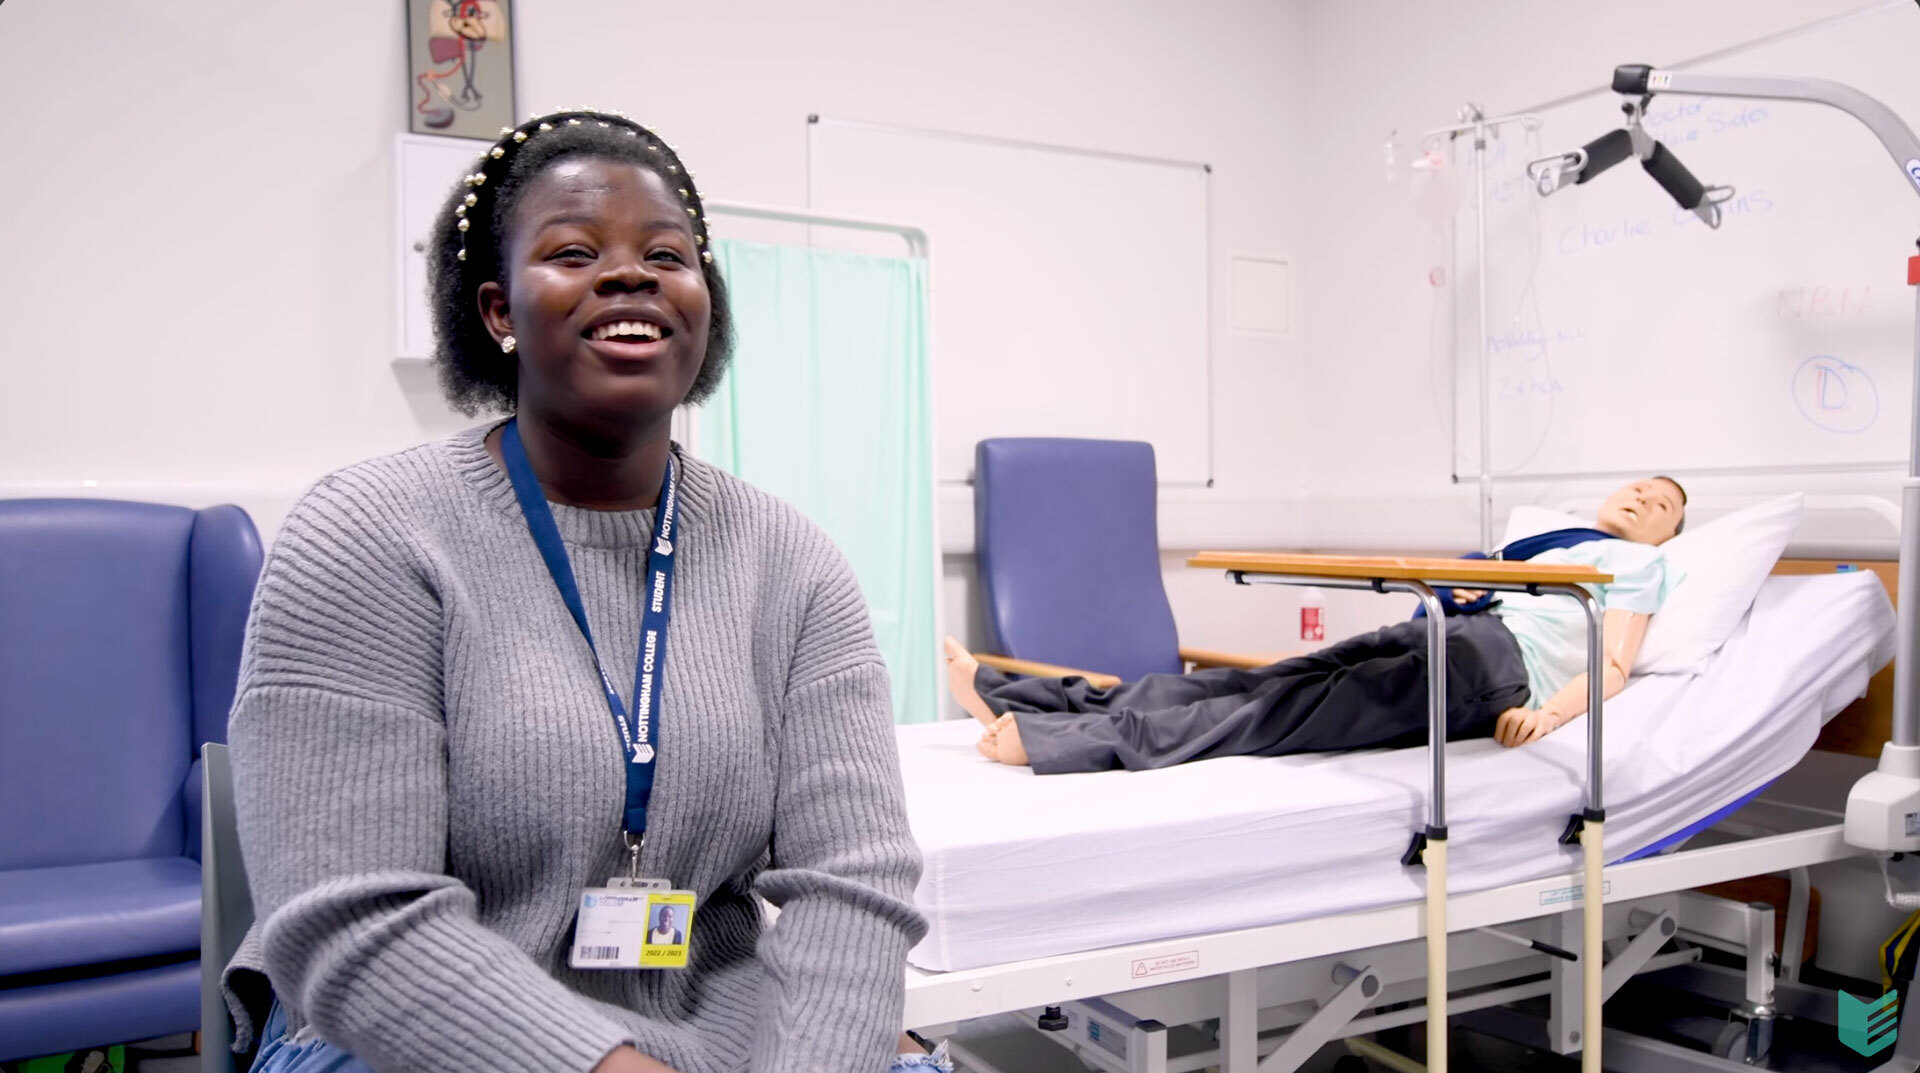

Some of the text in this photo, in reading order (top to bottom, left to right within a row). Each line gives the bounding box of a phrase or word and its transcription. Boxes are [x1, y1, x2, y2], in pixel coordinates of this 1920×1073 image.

[1559, 218, 1650, 255] Charlie
[661, 481, 676, 539] NOTTINGHAM
[651, 571, 666, 613] STUDENT
[638, 630, 657, 743] NOTTINGHAM COLLEGE
